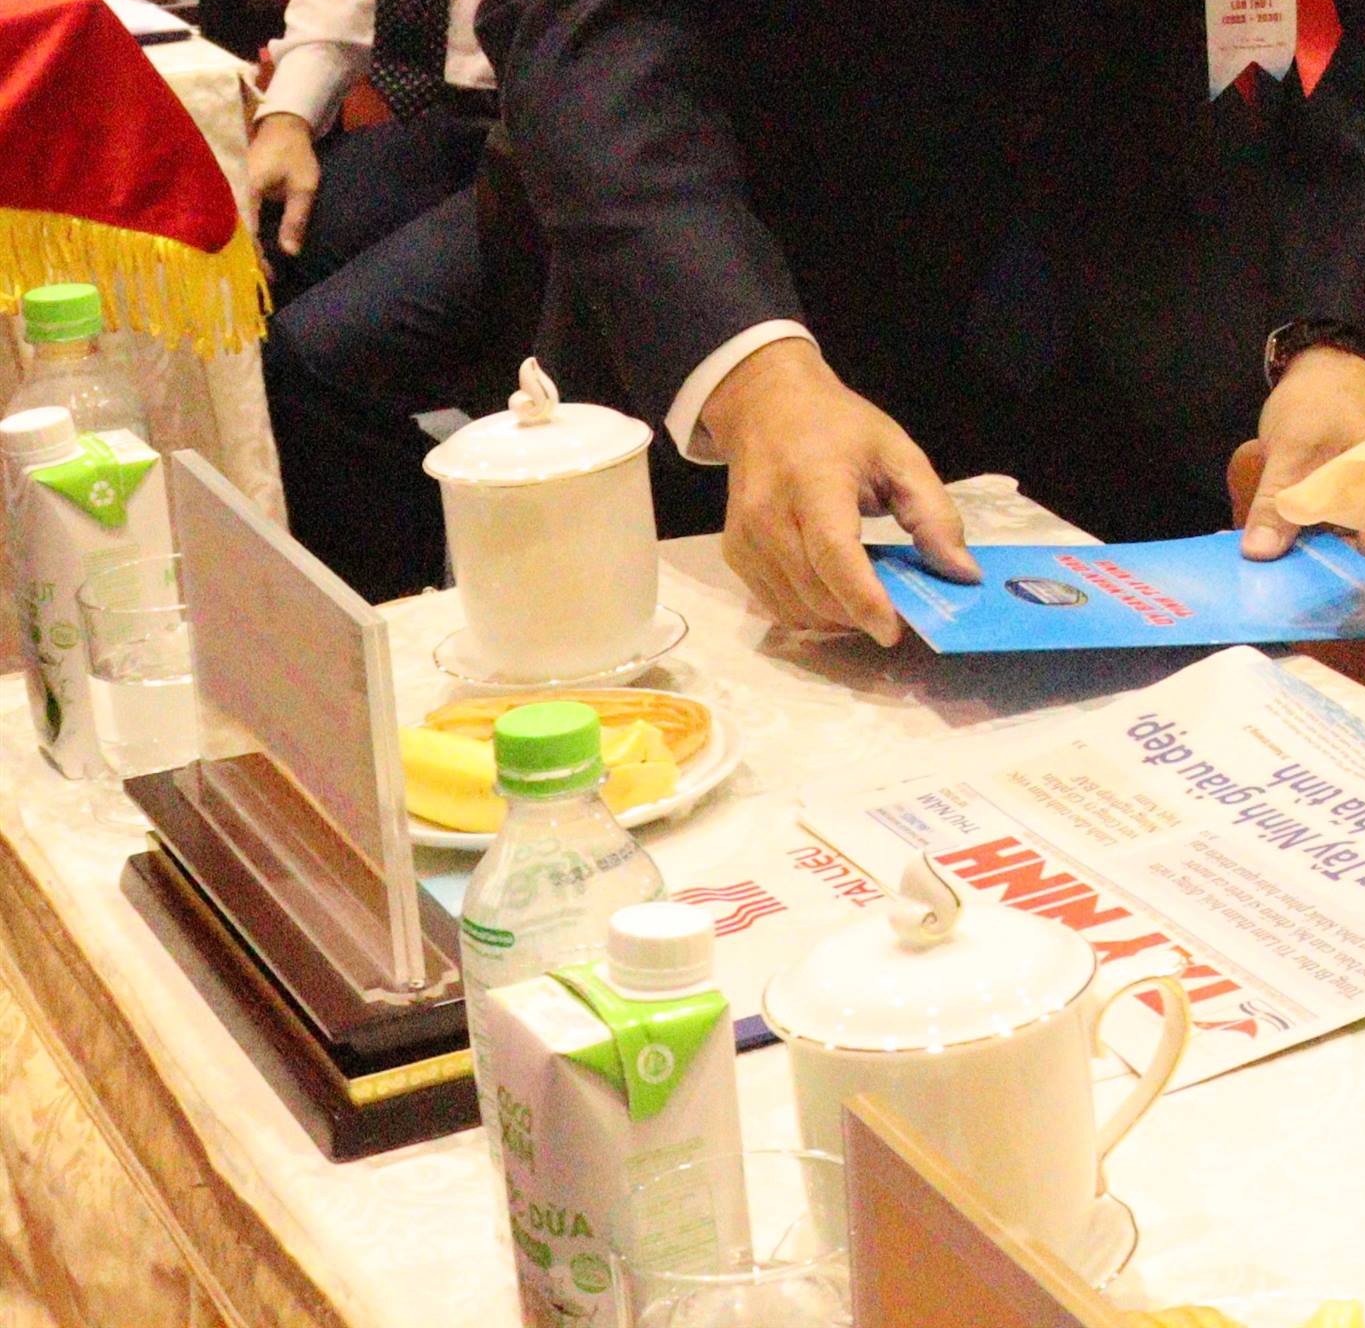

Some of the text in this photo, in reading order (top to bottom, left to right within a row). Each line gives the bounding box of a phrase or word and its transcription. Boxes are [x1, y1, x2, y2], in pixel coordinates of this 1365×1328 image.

[1127, 714, 1192, 765] đẹp,
[1178, 762, 1265, 804] giàu
[1268, 764, 1342, 805] tình
[1234, 803, 1320, 849] Ninh
[786, 846, 885, 908] TÀI LIỆU
[934, 835, 1134, 932] NINH
[1094, 931, 1242, 1017] TY
